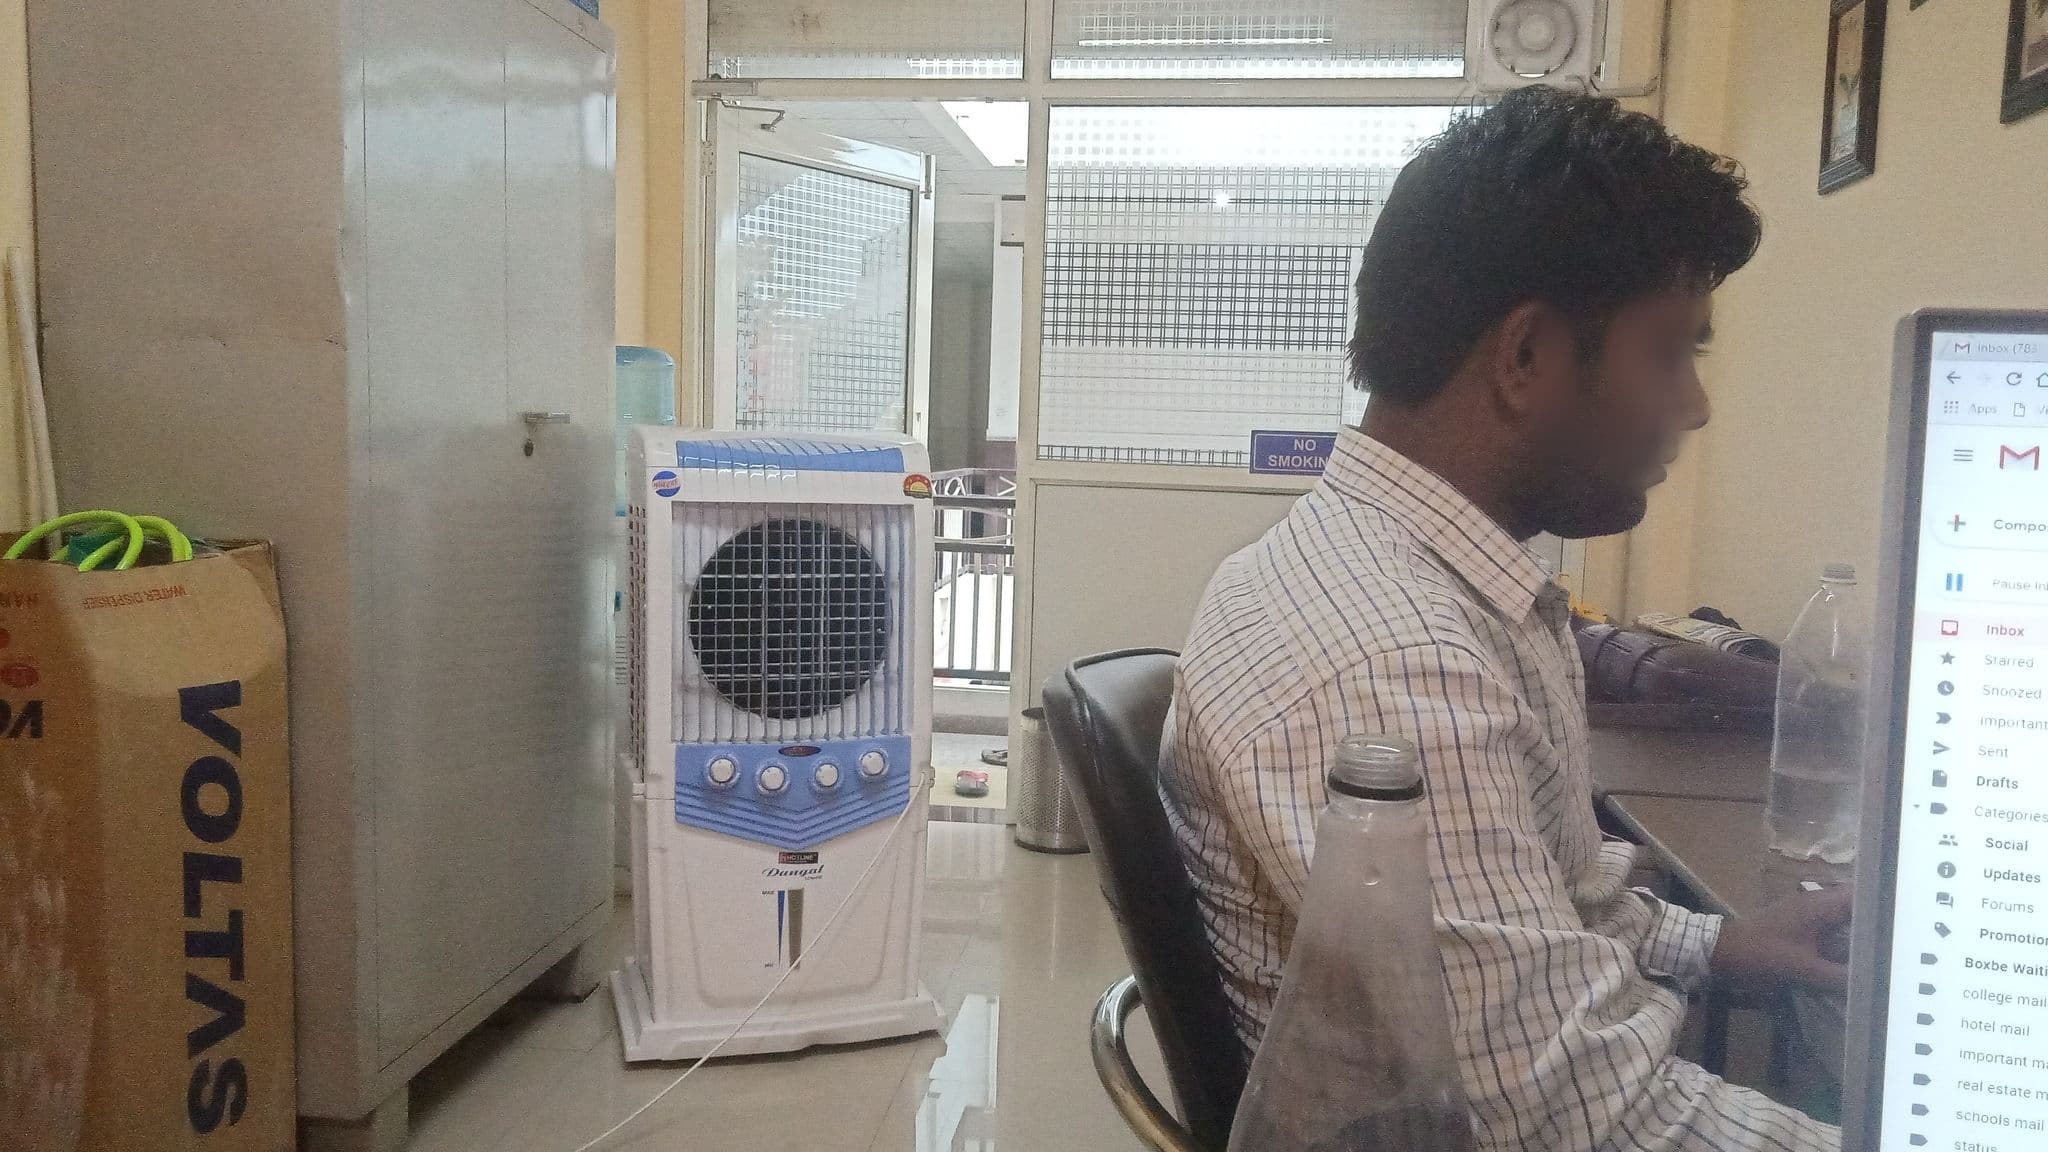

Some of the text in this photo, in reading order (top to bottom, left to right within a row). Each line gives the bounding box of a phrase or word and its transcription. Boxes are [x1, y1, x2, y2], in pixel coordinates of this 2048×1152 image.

[1978, 343, 2009, 354] Inbox
[1970, 404, 1997, 414] Apps
[1294, 439, 1316, 451] NO
[1994, 519, 2048, 533] Compo
[1992, 579, 2031, 591] Pause
[1986, 625, 2025, 637] Inbox
[1984, 655, 2034, 668] Starred
[1983, 684, 2042, 699] Snoozed
[1978, 745, 2008, 758] Sent
[1976, 776, 2019, 789] Drafts
[1974, 805, 2048, 822] Categories
[1985, 837, 2028, 851] Social
[762, 864, 824, 877] Dangal
[1983, 868, 2041, 883] Updates
[178, 680, 247, 1133] VOLTAS
[1981, 897, 2034, 913] Forums
[1964, 957, 2048, 976] Boxbe Waiti
[1963, 988, 2047, 1008] college mail
[1961, 1017, 2030, 1036] hotel mail
[1959, 1048, 2027, 1067] important
[1957, 1080, 1983, 1092] real
[1987, 1084, 2031, 1098] estate
[1956, 1110, 2044, 1131] schools mail
[1953, 1141, 1999, 1152] status
